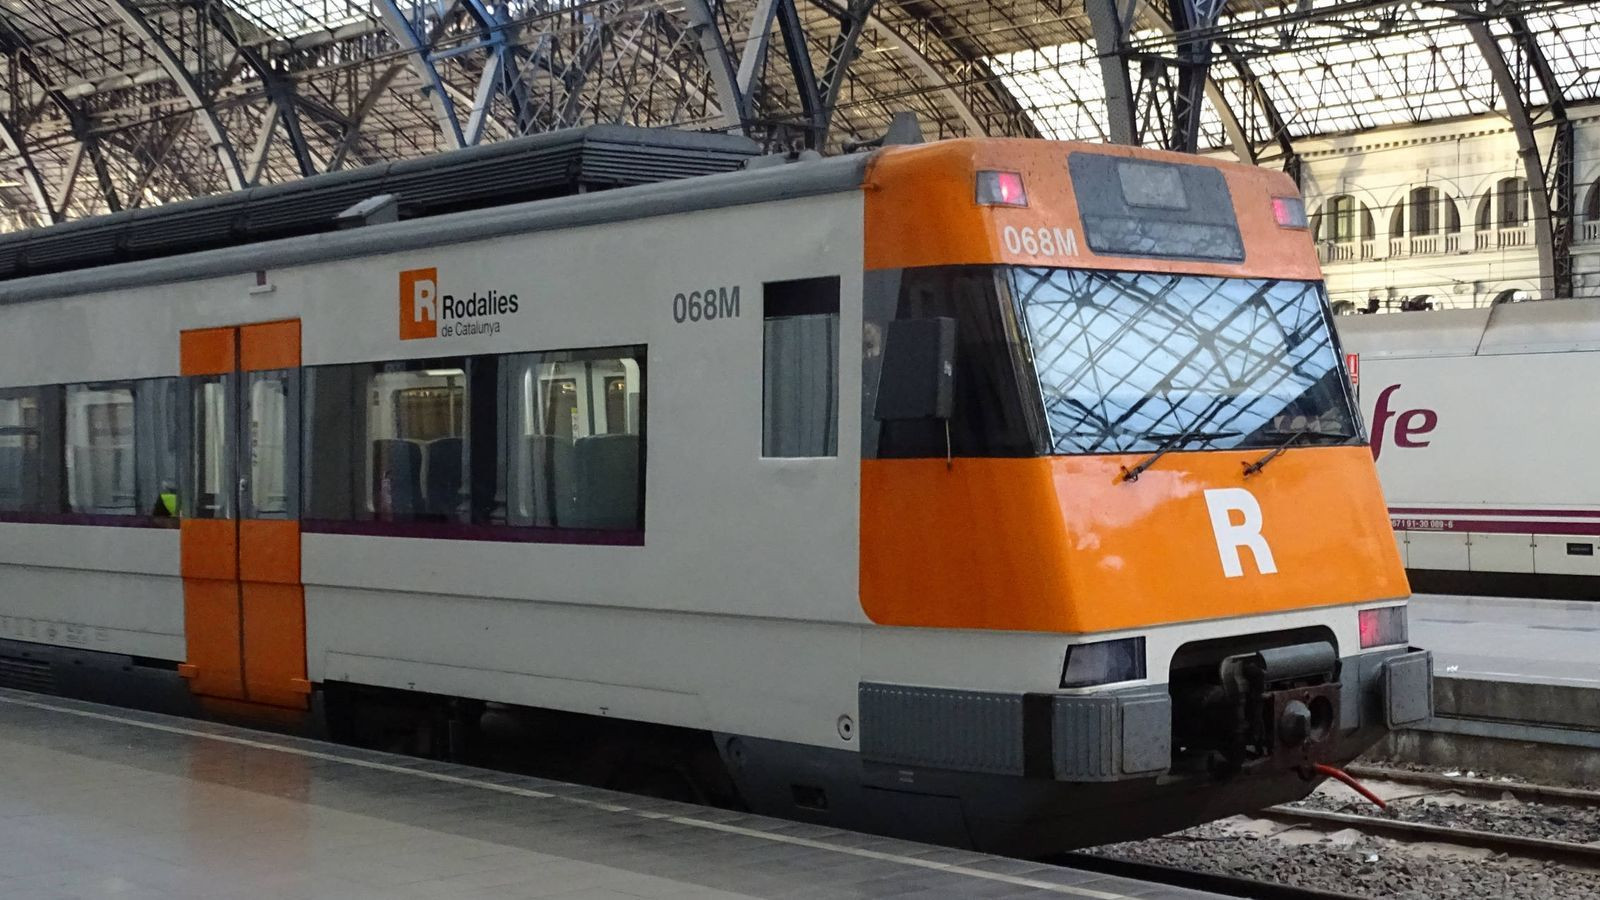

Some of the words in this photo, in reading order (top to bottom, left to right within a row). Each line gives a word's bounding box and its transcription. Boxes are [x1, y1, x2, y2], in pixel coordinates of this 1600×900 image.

[1004, 225, 1079, 257] 068M
[413, 279, 437, 323] R
[442, 289, 519, 320] Rodalies
[673, 285, 740, 324] 068M
[441, 324, 453, 338] de
[456, 321, 500, 337] Catalunya
[1203, 487, 1279, 578] R
